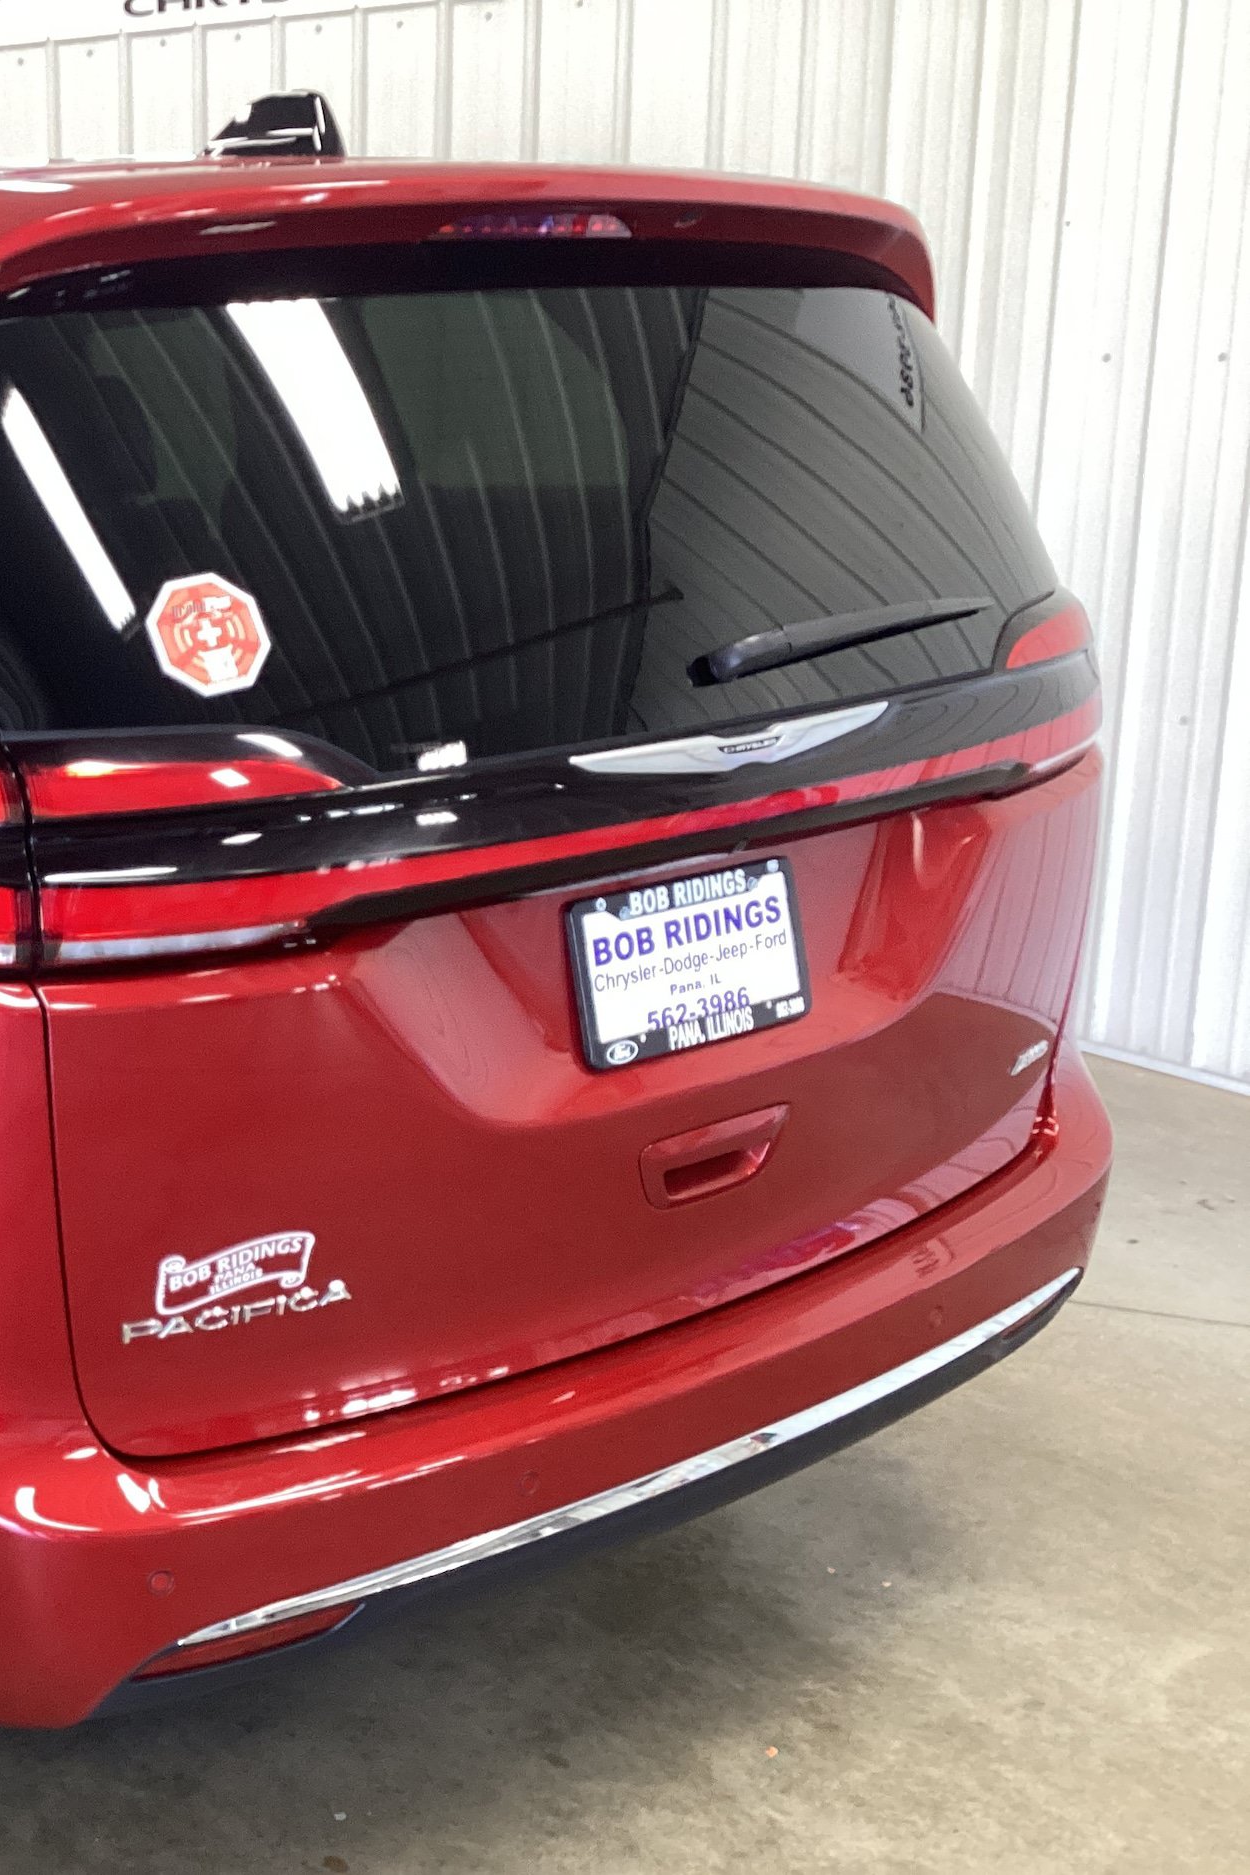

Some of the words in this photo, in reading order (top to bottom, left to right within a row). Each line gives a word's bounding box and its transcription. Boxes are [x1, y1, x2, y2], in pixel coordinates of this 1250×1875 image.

[629, 885, 670, 916] BOB
[673, 868, 747, 907] RIDINGS
[593, 926, 655, 967] BOB
[664, 896, 781, 949] RIDINGS
[710, 973, 722, 985] IL
[647, 986, 750, 1031] 562-3986
[706, 1005, 754, 1041] ILLINOIS
[169, 1265, 211, 1292] BOB
[217, 1237, 302, 1273] RIDINGS
[122, 1280, 352, 1344] PACIFICA
